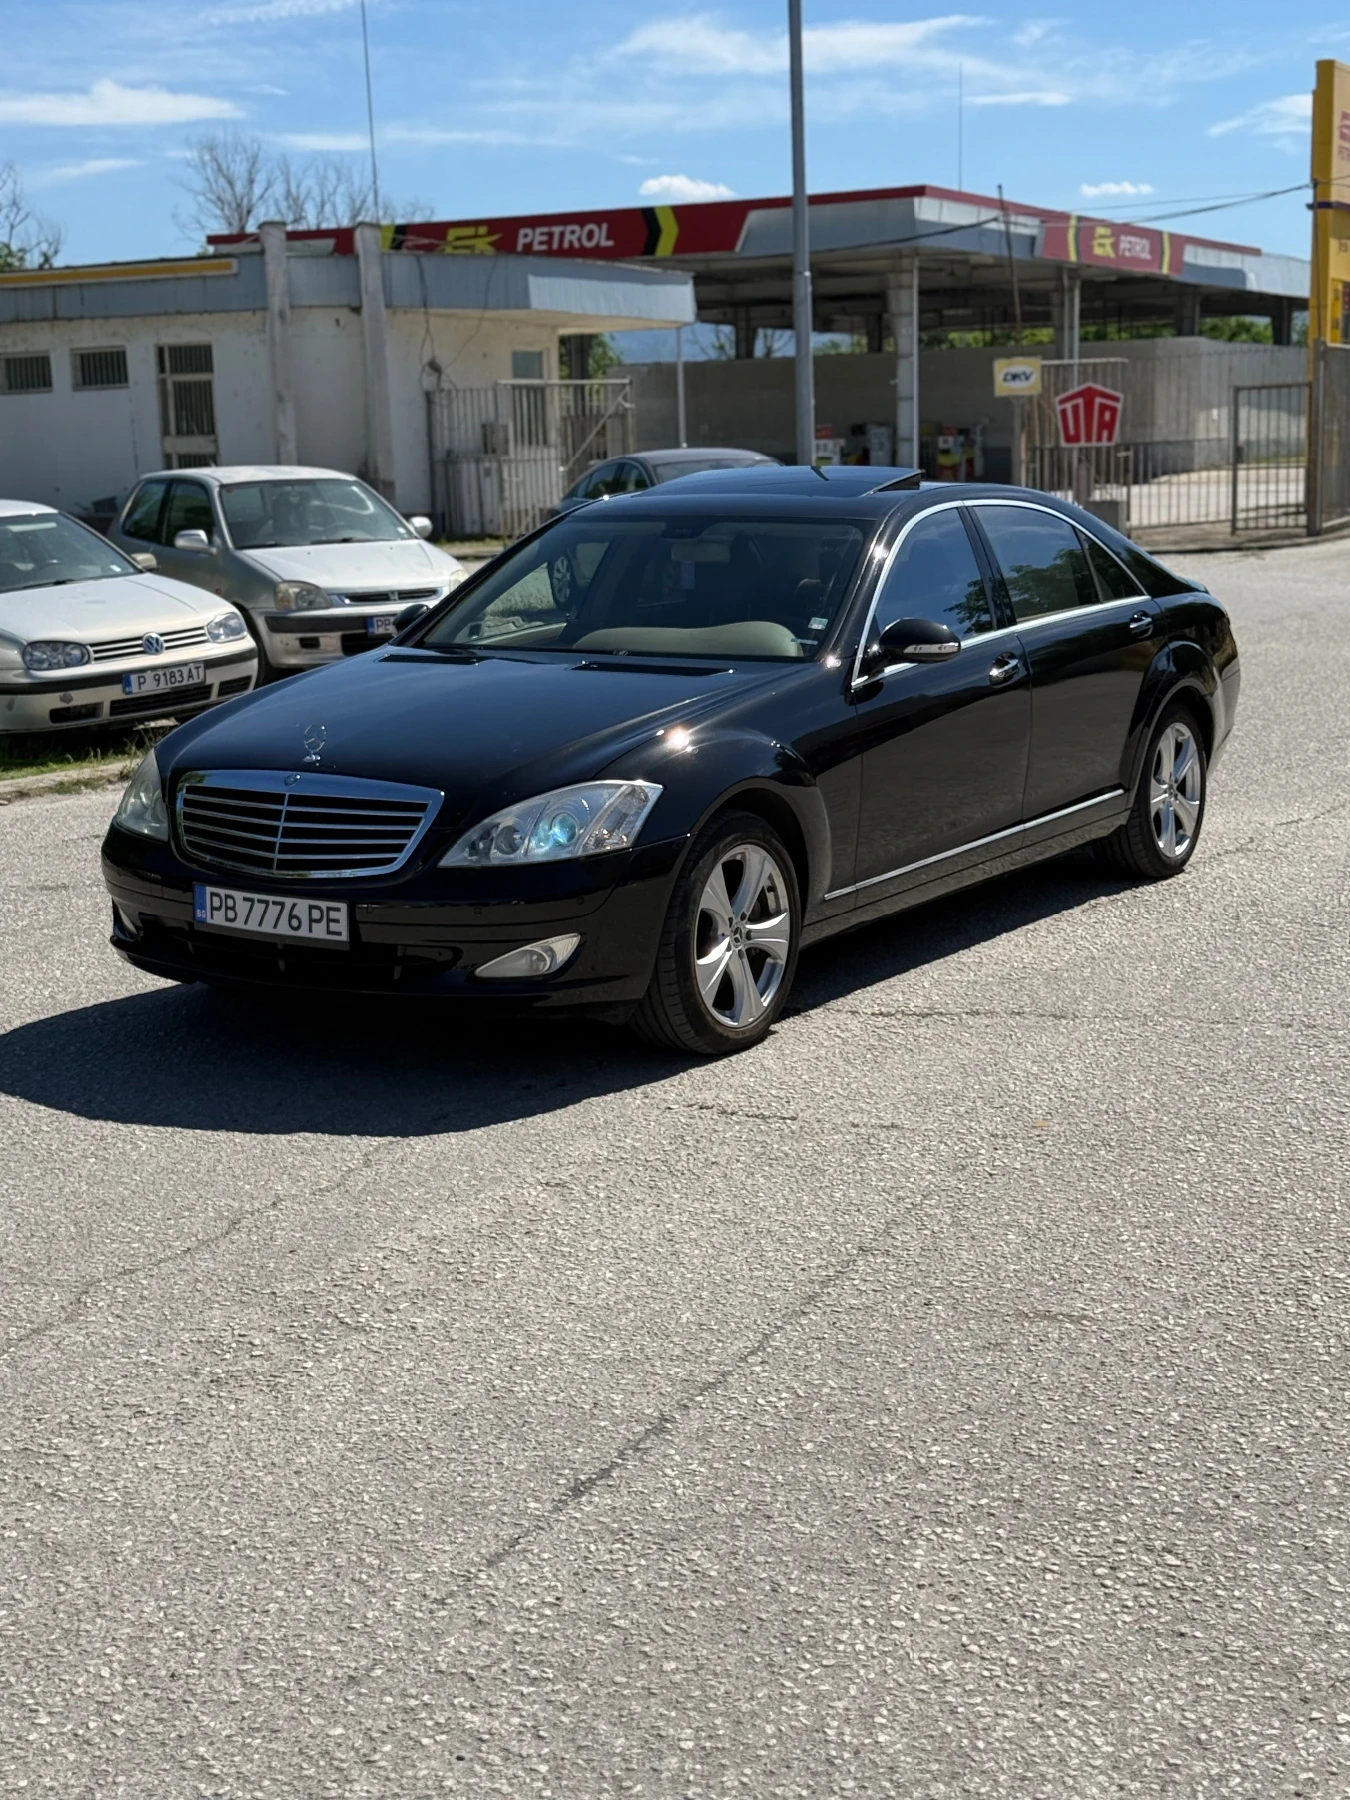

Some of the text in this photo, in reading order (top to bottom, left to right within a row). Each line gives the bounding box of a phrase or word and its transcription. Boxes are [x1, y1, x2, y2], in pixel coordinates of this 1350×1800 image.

[516, 222, 615, 252] PETROL
[1002, 371, 1034, 383] DKV
[1057, 385, 1121, 445] UTA
